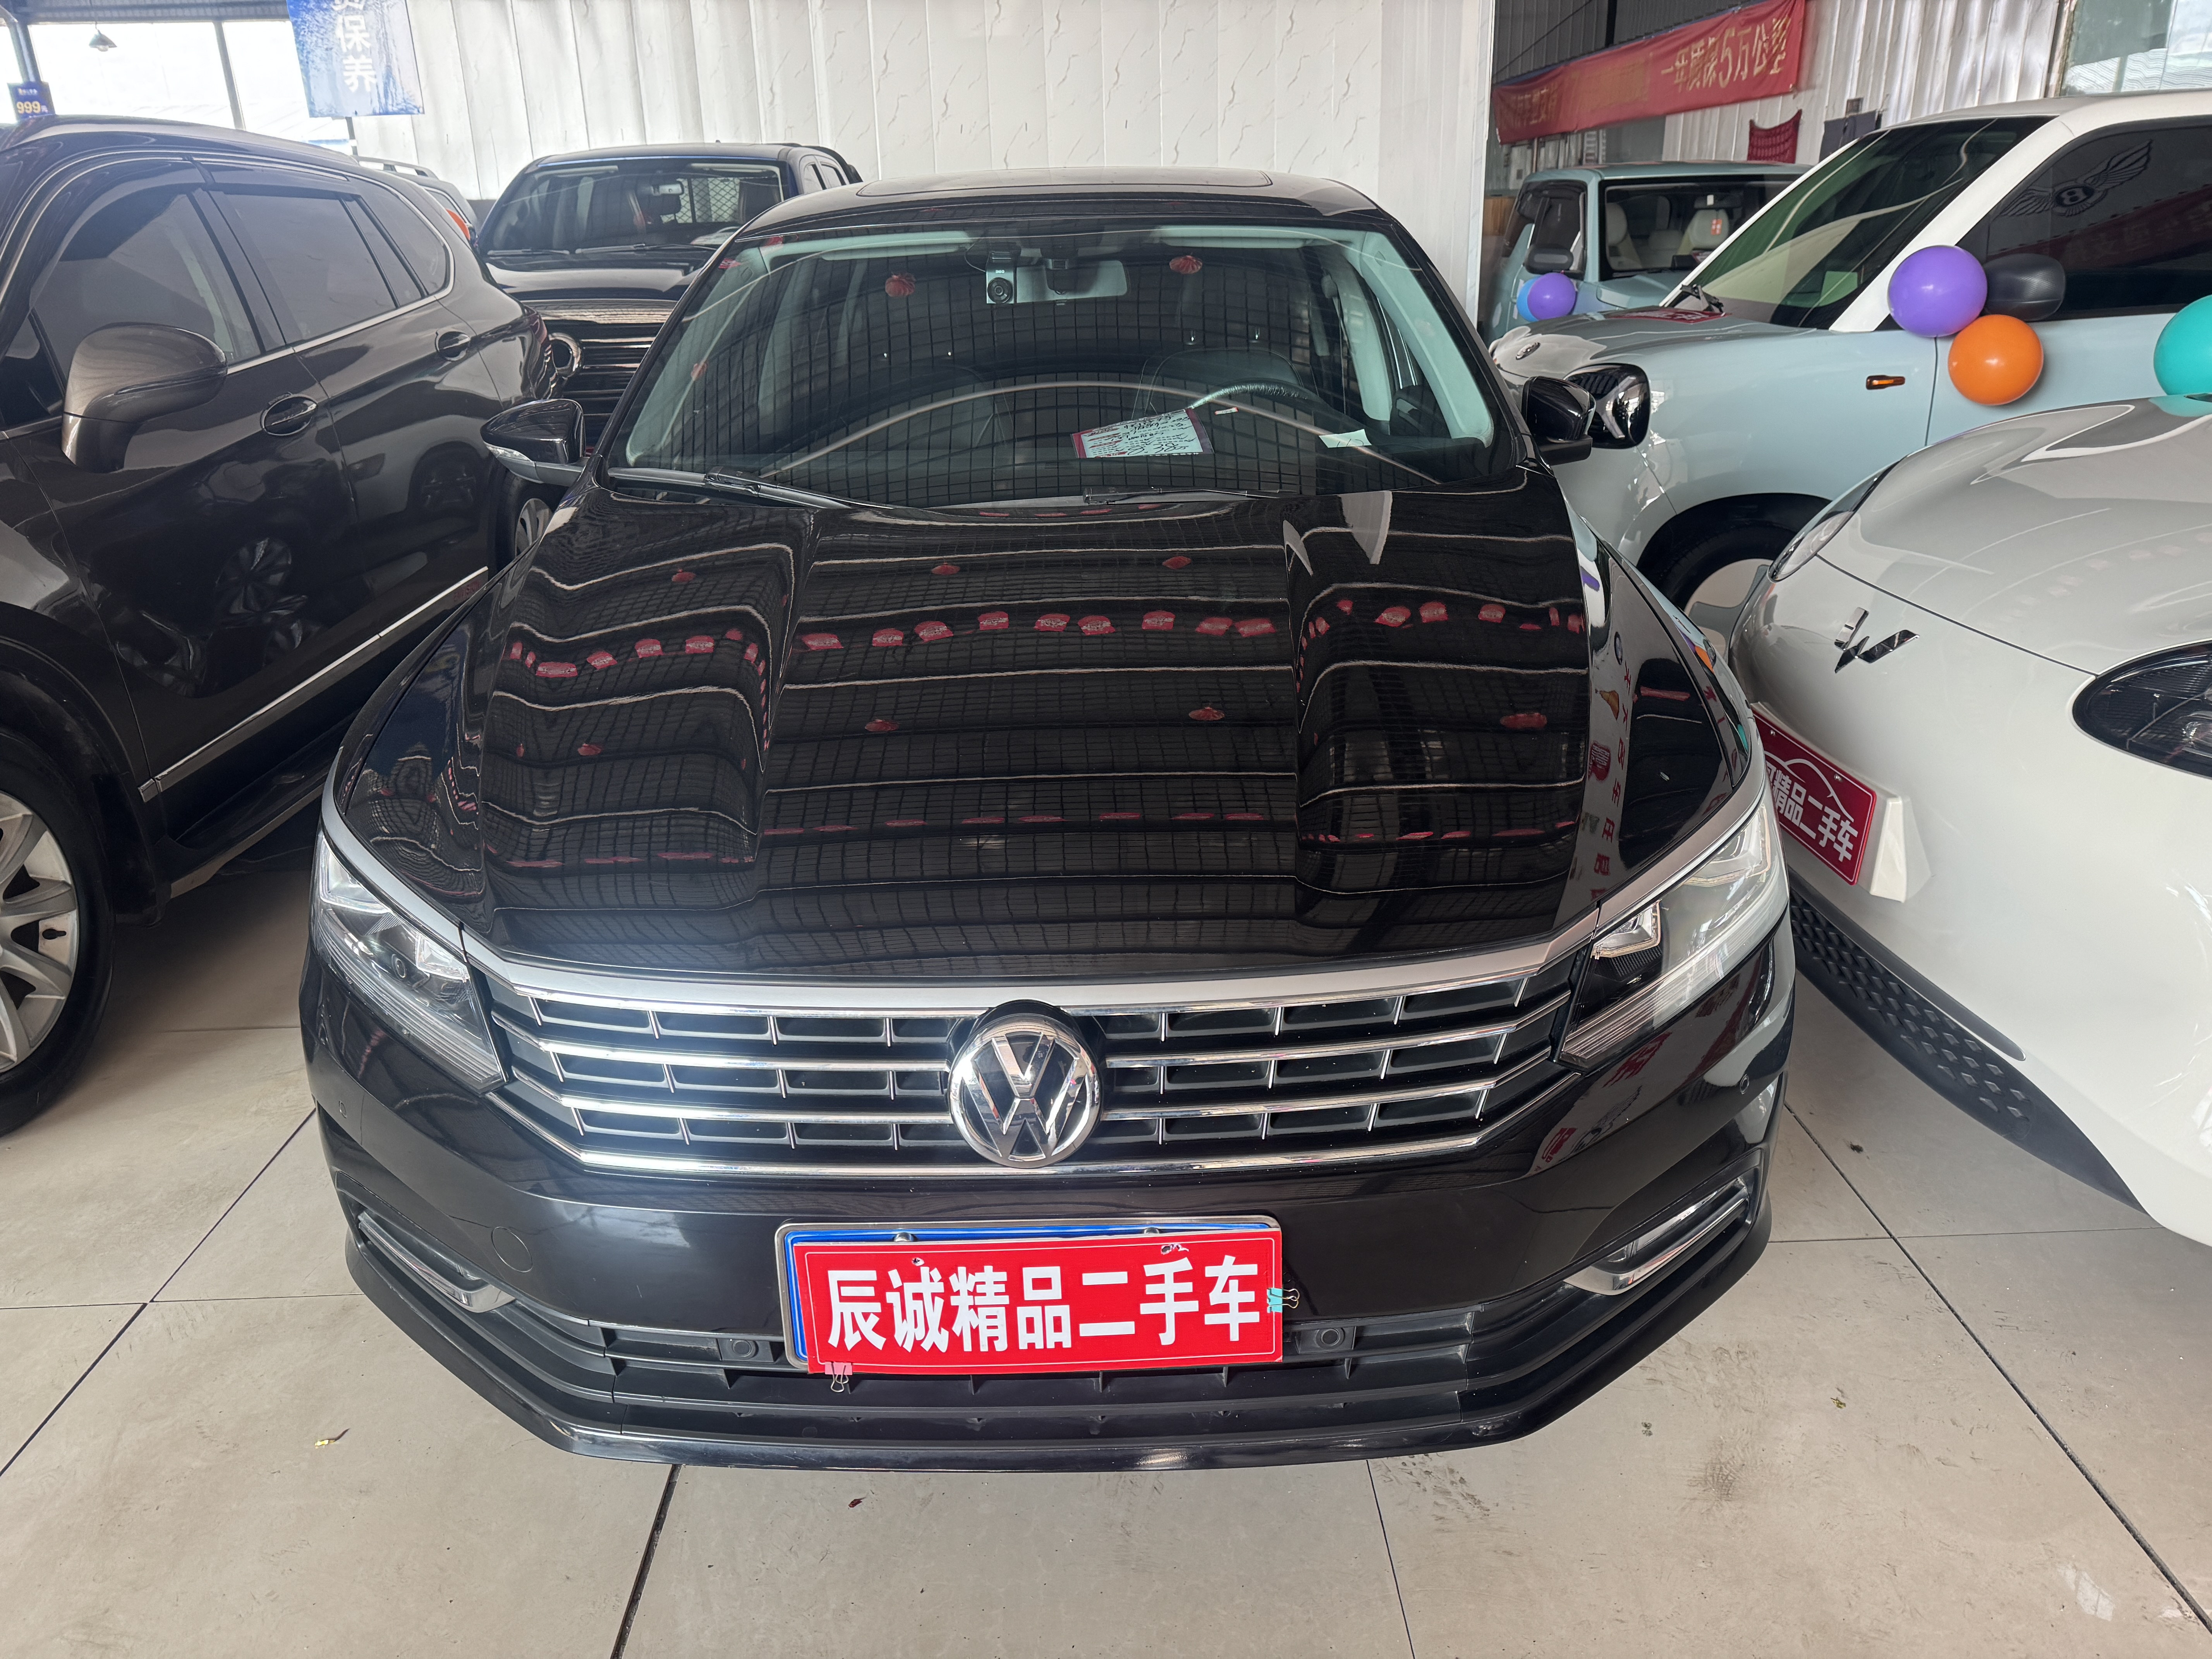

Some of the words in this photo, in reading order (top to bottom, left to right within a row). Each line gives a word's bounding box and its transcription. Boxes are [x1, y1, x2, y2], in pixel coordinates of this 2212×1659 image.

[332, 0, 377, 92] 保养
[828, 1255, 1260, 1353] 辰诚精品二手车
